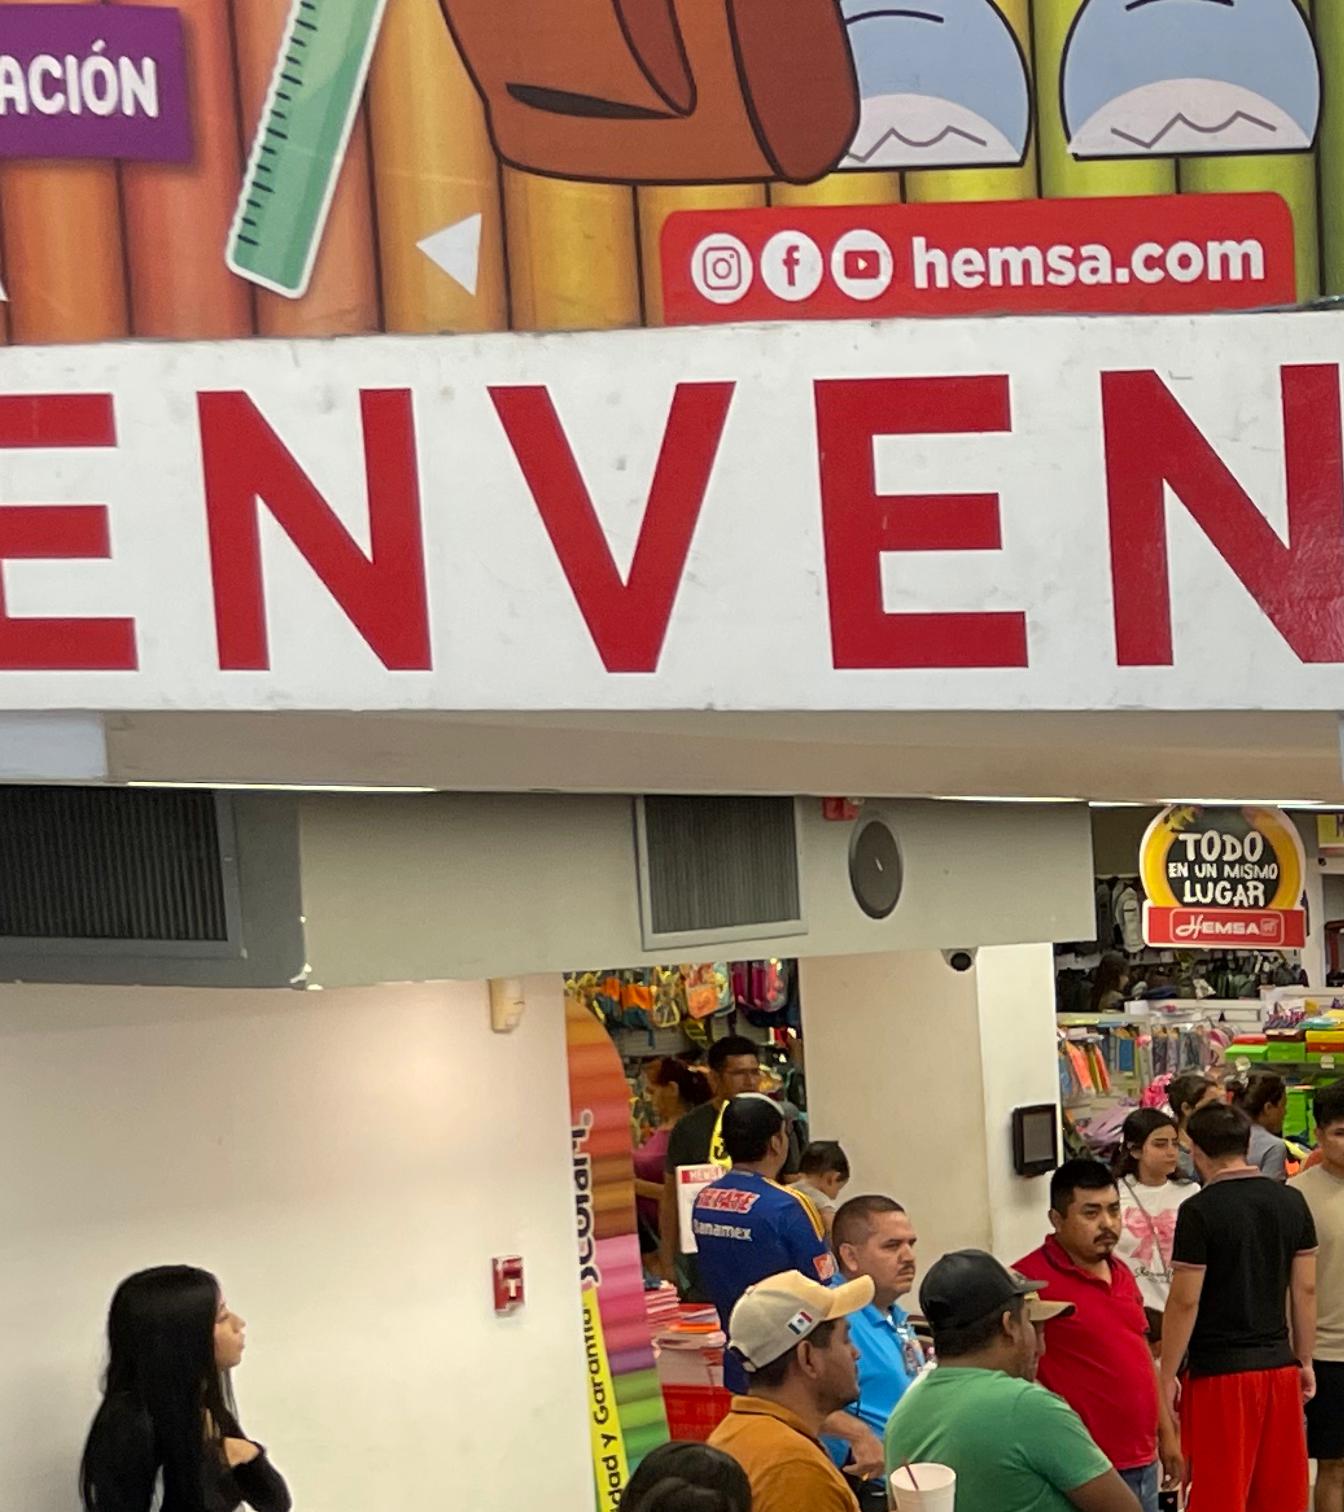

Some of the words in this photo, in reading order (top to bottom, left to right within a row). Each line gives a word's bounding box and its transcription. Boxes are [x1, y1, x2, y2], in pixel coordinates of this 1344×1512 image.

[0, 39, 160, 118] ACIÓN
[911, 232, 1267, 290] hemsa.com
[1178, 830, 1263, 862] TODO
[1168, 863, 1188, 878] EN
[1195, 864, 1217, 878] UN
[1224, 864, 1278, 879] MISMO
[1183, 880, 1265, 907] LUGAR
[1176, 914, 1260, 939] HEMSA
[600, 1432, 617, 1449] y
